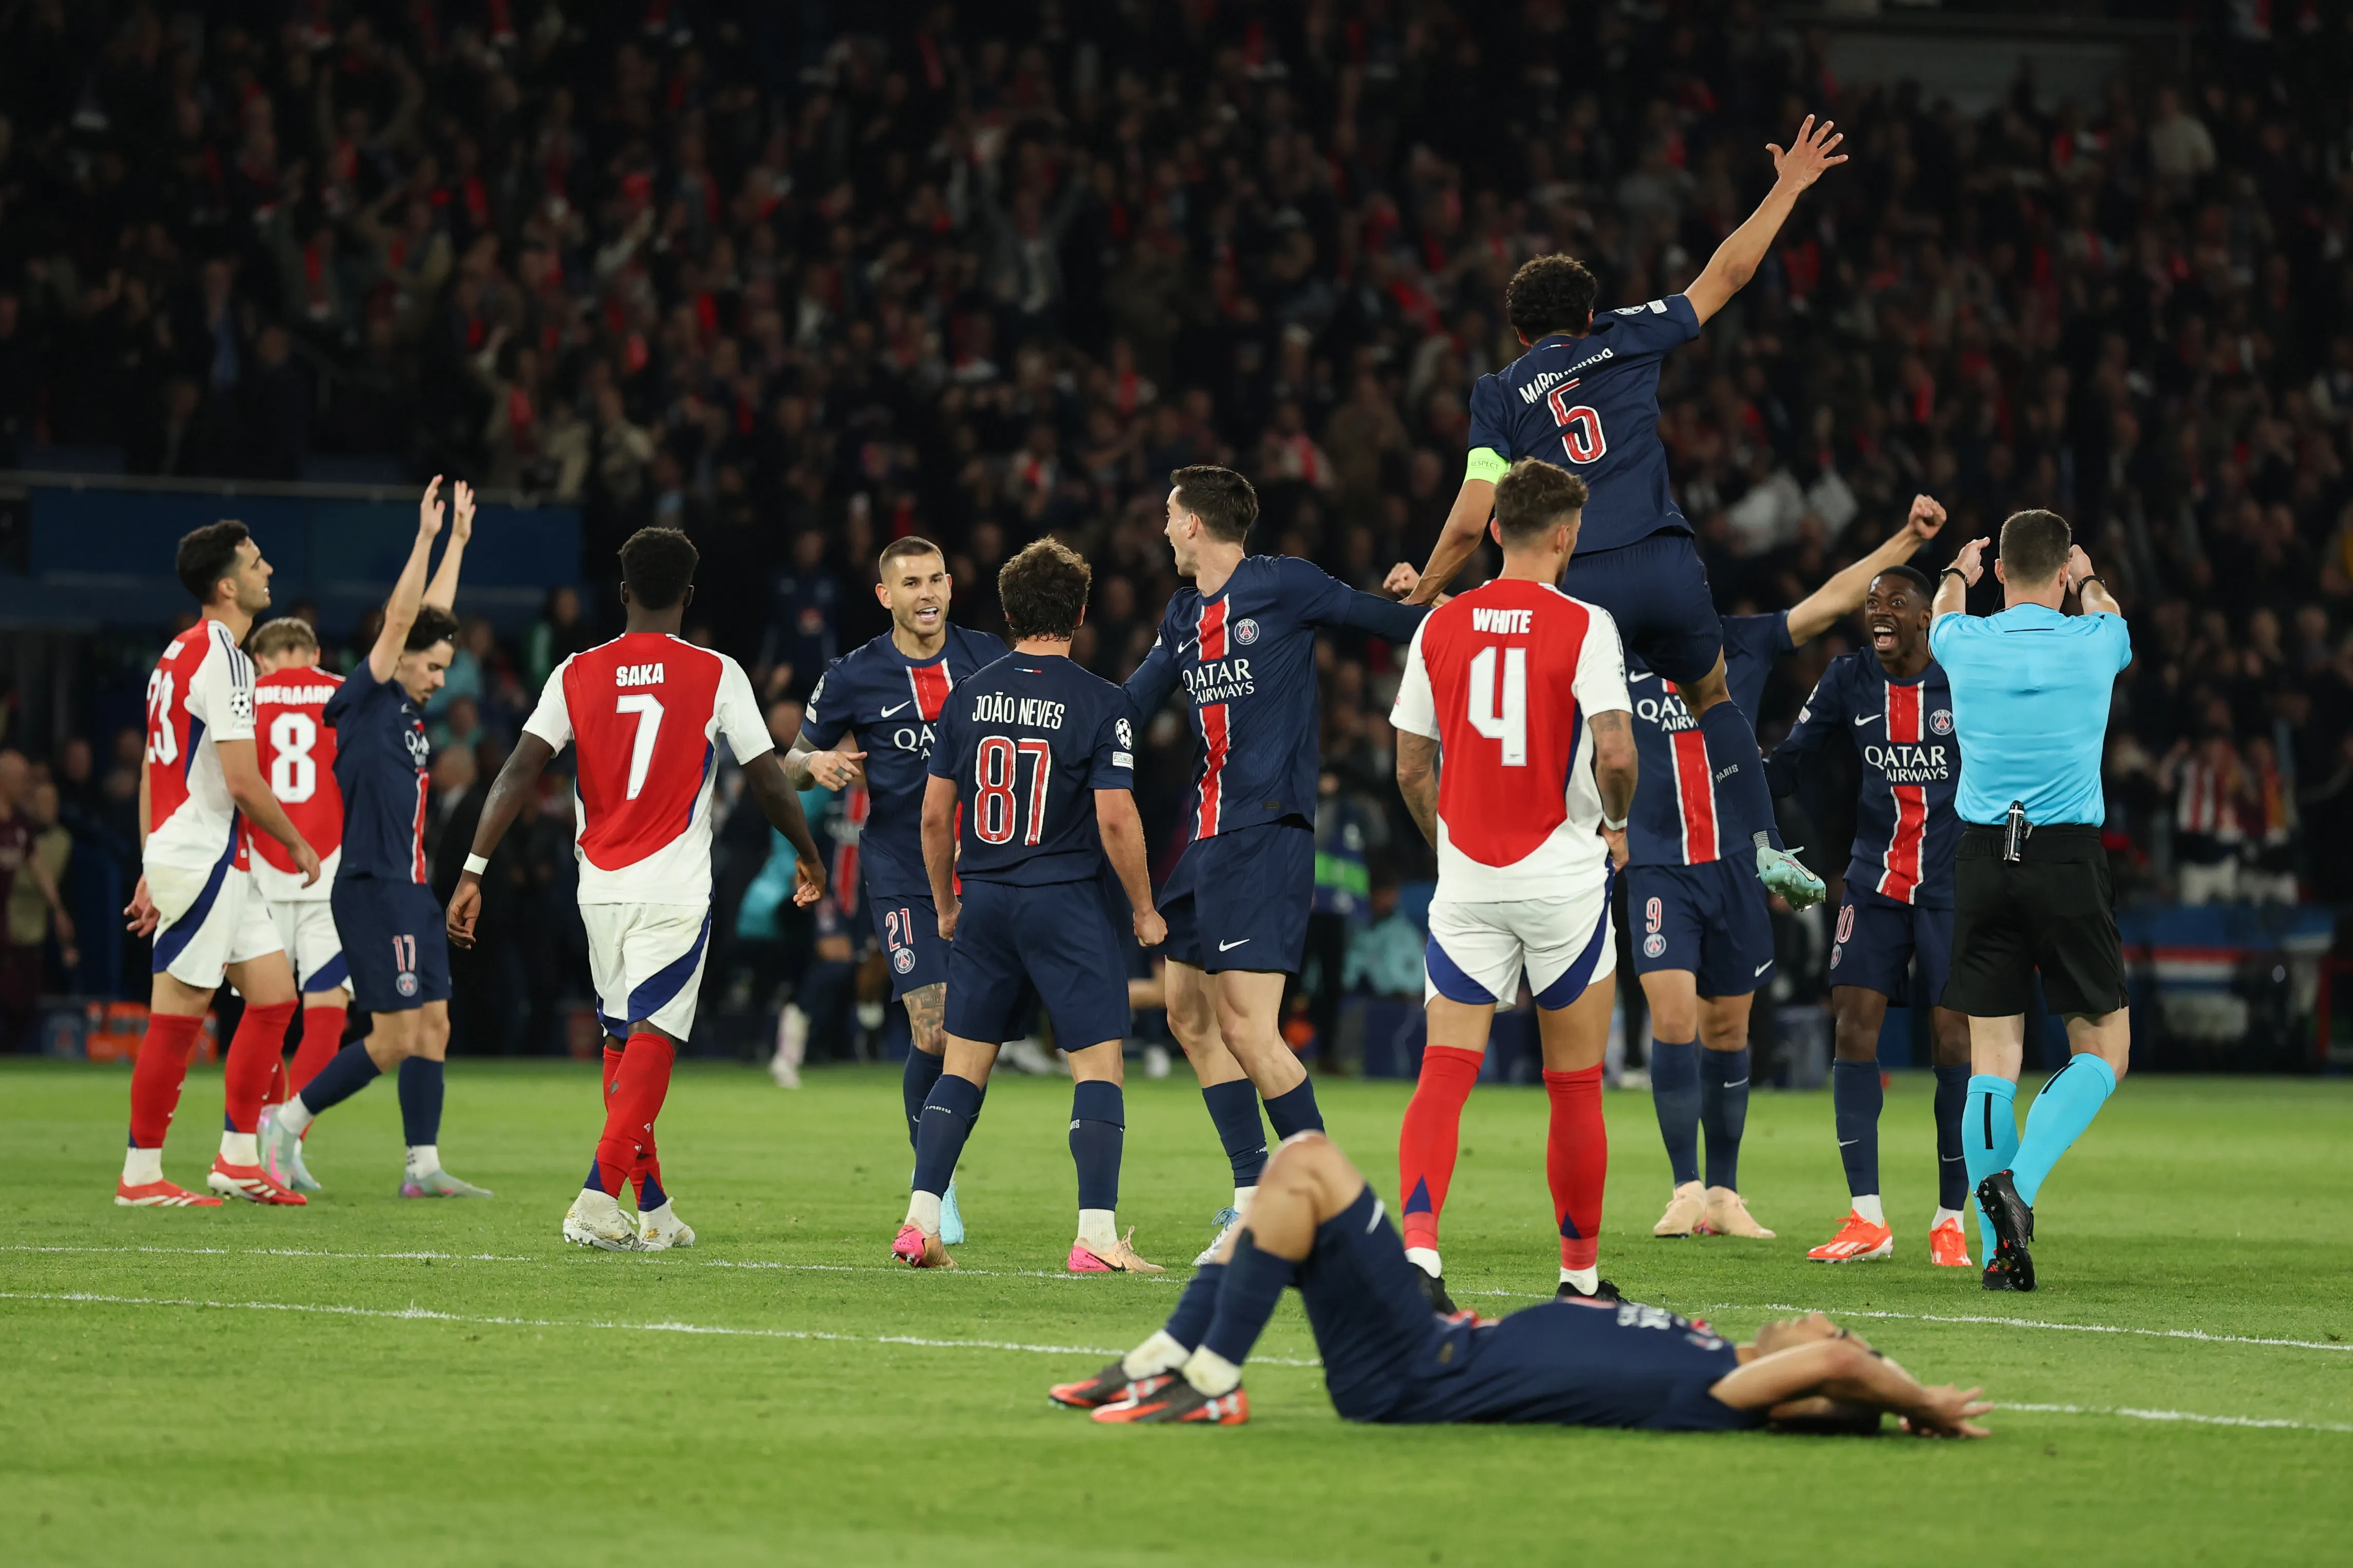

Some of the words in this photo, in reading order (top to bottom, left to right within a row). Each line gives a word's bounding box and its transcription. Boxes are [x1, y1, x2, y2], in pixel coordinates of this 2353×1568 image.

[1547, 377, 1607, 464] 5
[1470, 460, 1499, 470] RESPECT
[1472, 607, 1534, 634] WHITE
[616, 662, 664, 687] SAKA
[1182, 658, 1253, 695] QATAR
[1195, 681, 1255, 704] AIRWAYS
[972, 691, 1015, 723] JOÃO
[1018, 698, 1065, 730] NEVES
[1467, 646, 1527, 767] 4
[270, 712, 317, 804] 8
[616, 693, 665, 800] 7
[1864, 745, 1947, 771] QATAR
[974, 735, 1051, 846] 87
[1716, 764, 1739, 783] PARIS
[1886, 766, 1949, 782] AIRWAYS
[885, 908, 913, 952] 21
[1646, 896, 1662, 934] 9
[1833, 904, 1854, 945] 10
[392, 934, 416, 972] 17
